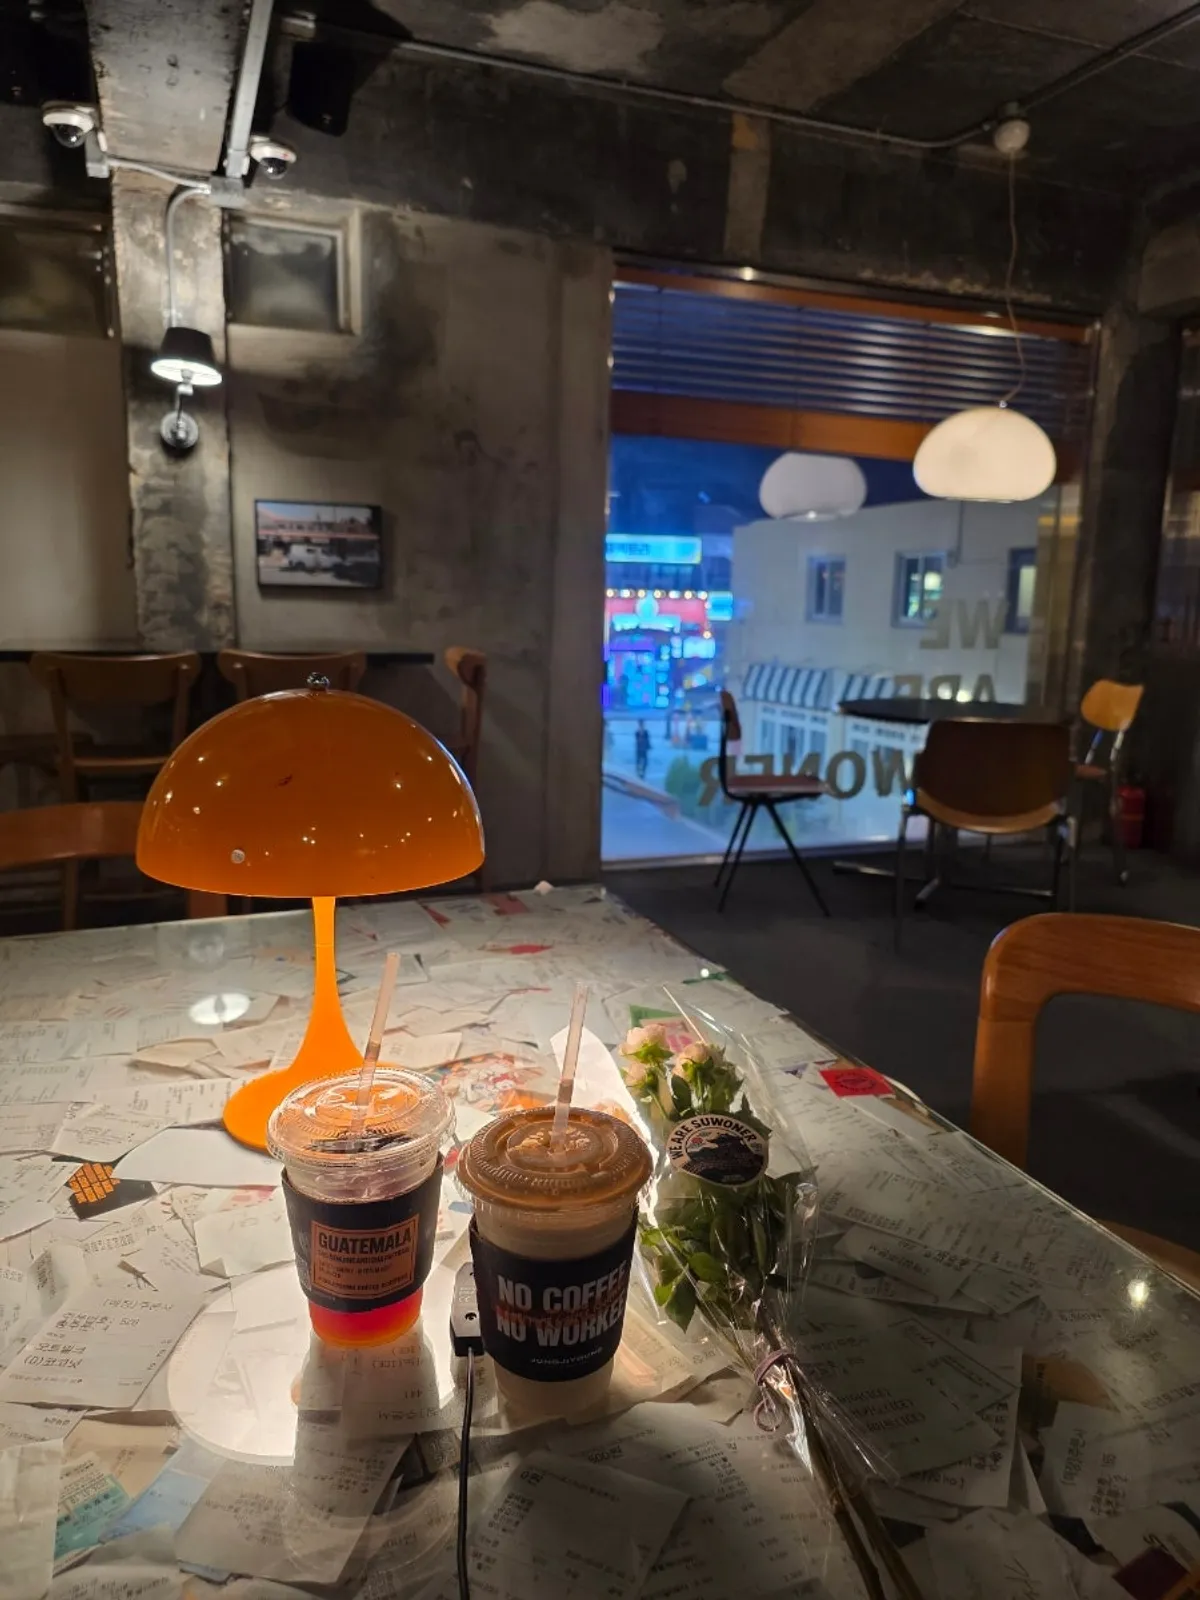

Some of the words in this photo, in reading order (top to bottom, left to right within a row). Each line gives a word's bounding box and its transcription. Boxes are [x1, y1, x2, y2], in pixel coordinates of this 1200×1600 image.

[671, 1124, 693, 1147] ARE
[690, 1117, 757, 1142] SUWONER
[668, 1146, 684, 1160] WE
[318, 1225, 412, 1255] GUATEMALA
[497, 1274, 532, 1311] NO
[542, 1260, 627, 1313] COFFEE
[496, 1306, 527, 1342] NO
